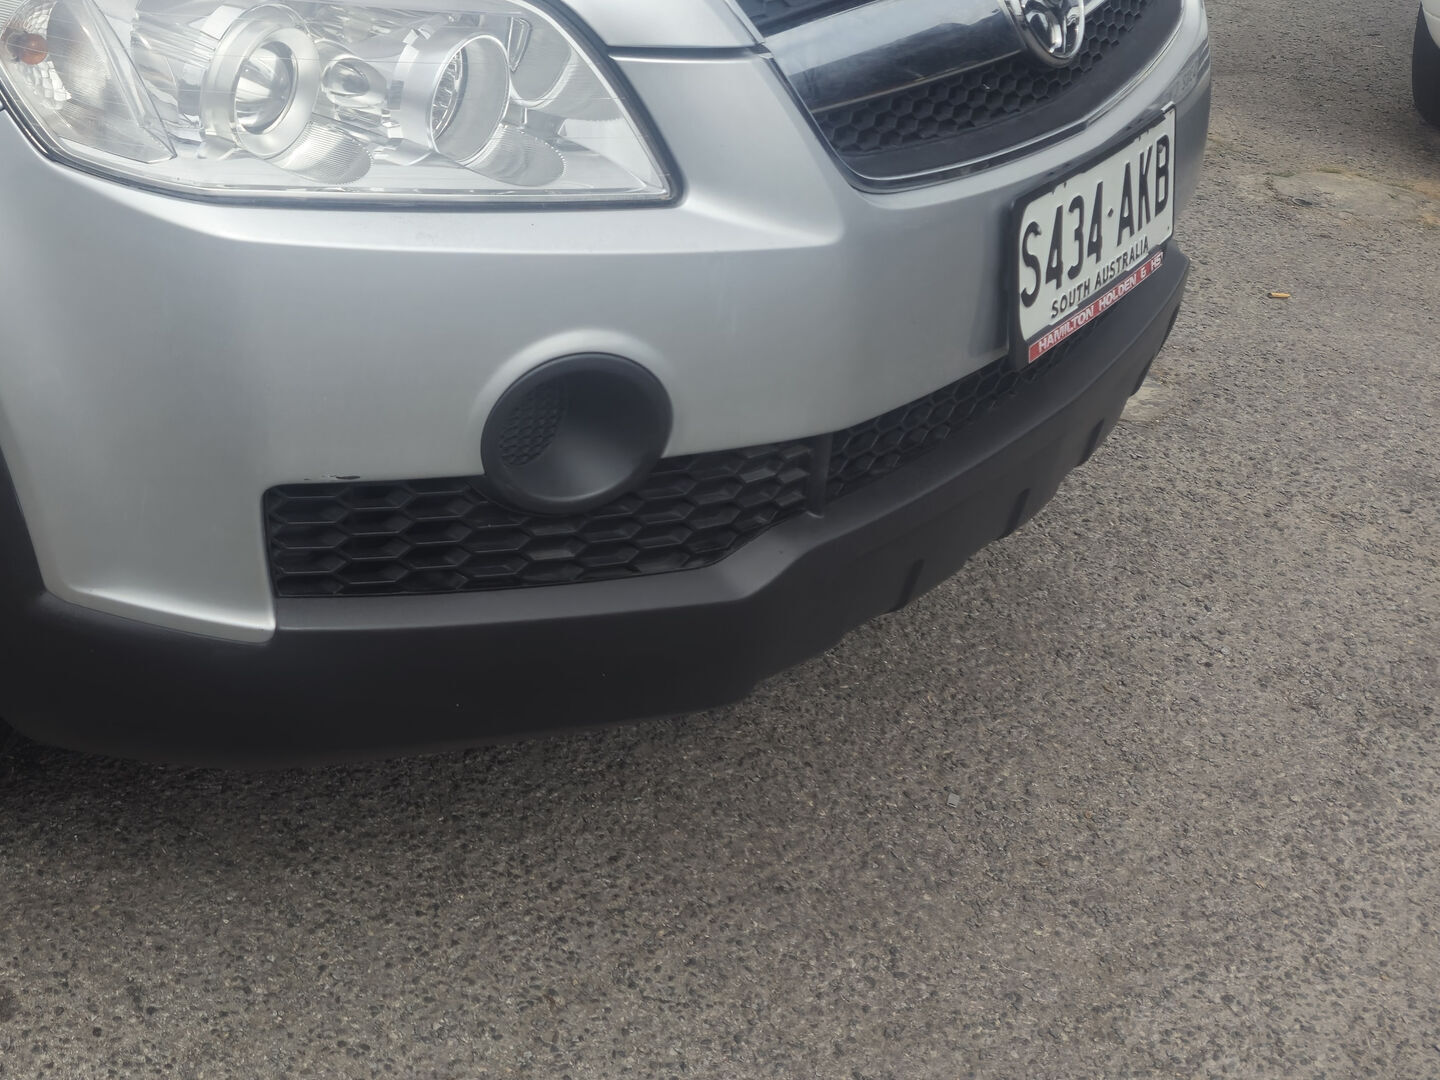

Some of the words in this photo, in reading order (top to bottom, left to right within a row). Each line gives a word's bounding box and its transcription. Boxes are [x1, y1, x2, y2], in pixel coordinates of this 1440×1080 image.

[1038, 305, 1095, 353] HAMILTON
[1098, 273, 1137, 311] HOLDEN
[1051, 278, 1090, 319] SOUTH
[1094, 236, 1149, 290] AUSTRALIA
